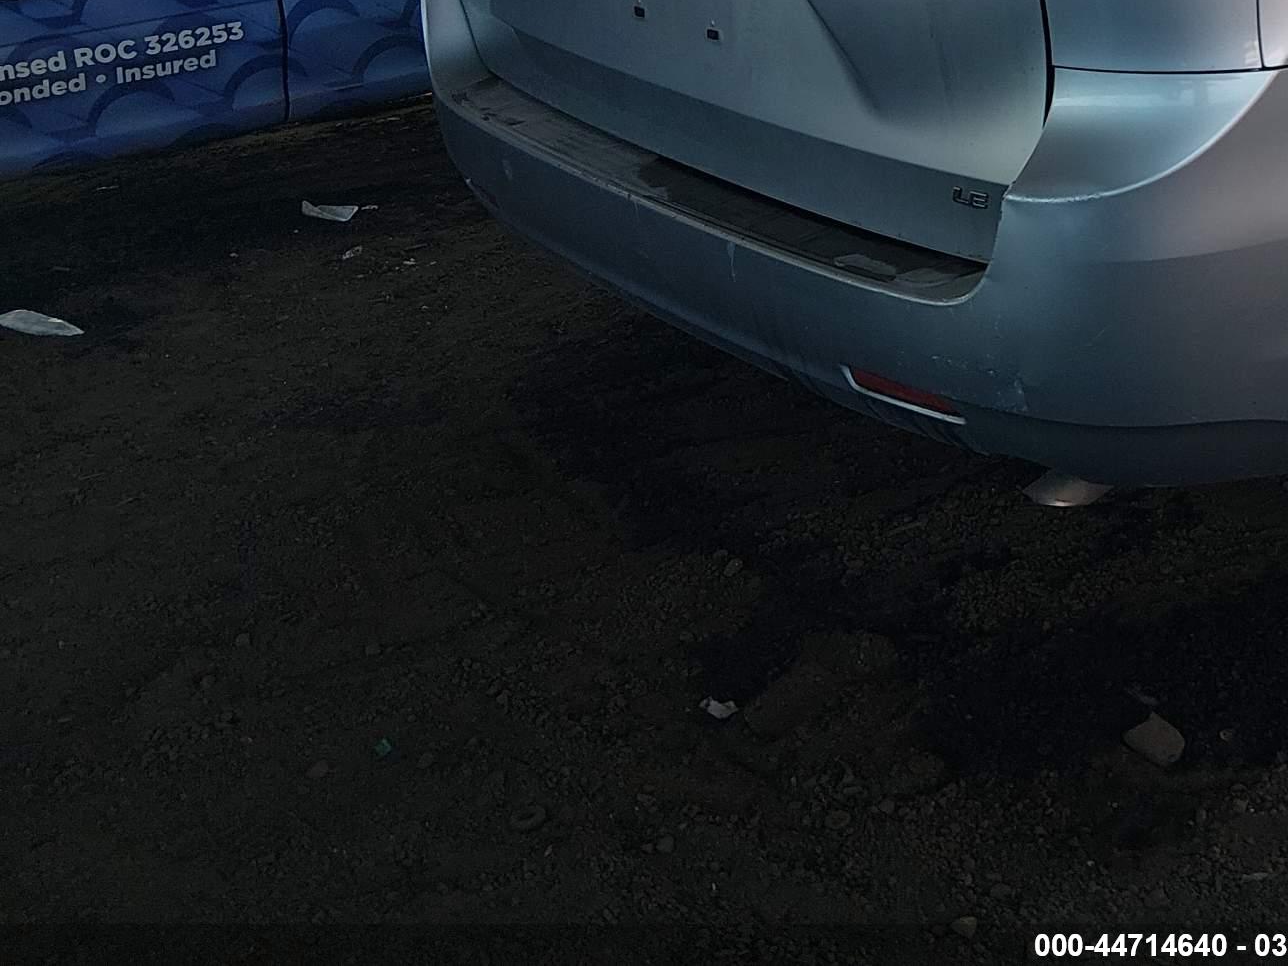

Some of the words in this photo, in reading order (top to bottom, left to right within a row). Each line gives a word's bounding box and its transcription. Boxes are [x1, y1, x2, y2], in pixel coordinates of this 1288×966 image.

[74, 40, 137, 68] ROC
[144, 21, 244, 55] 326253
[116, 50, 217, 84] Insured
[952, 185, 989, 209] LE
